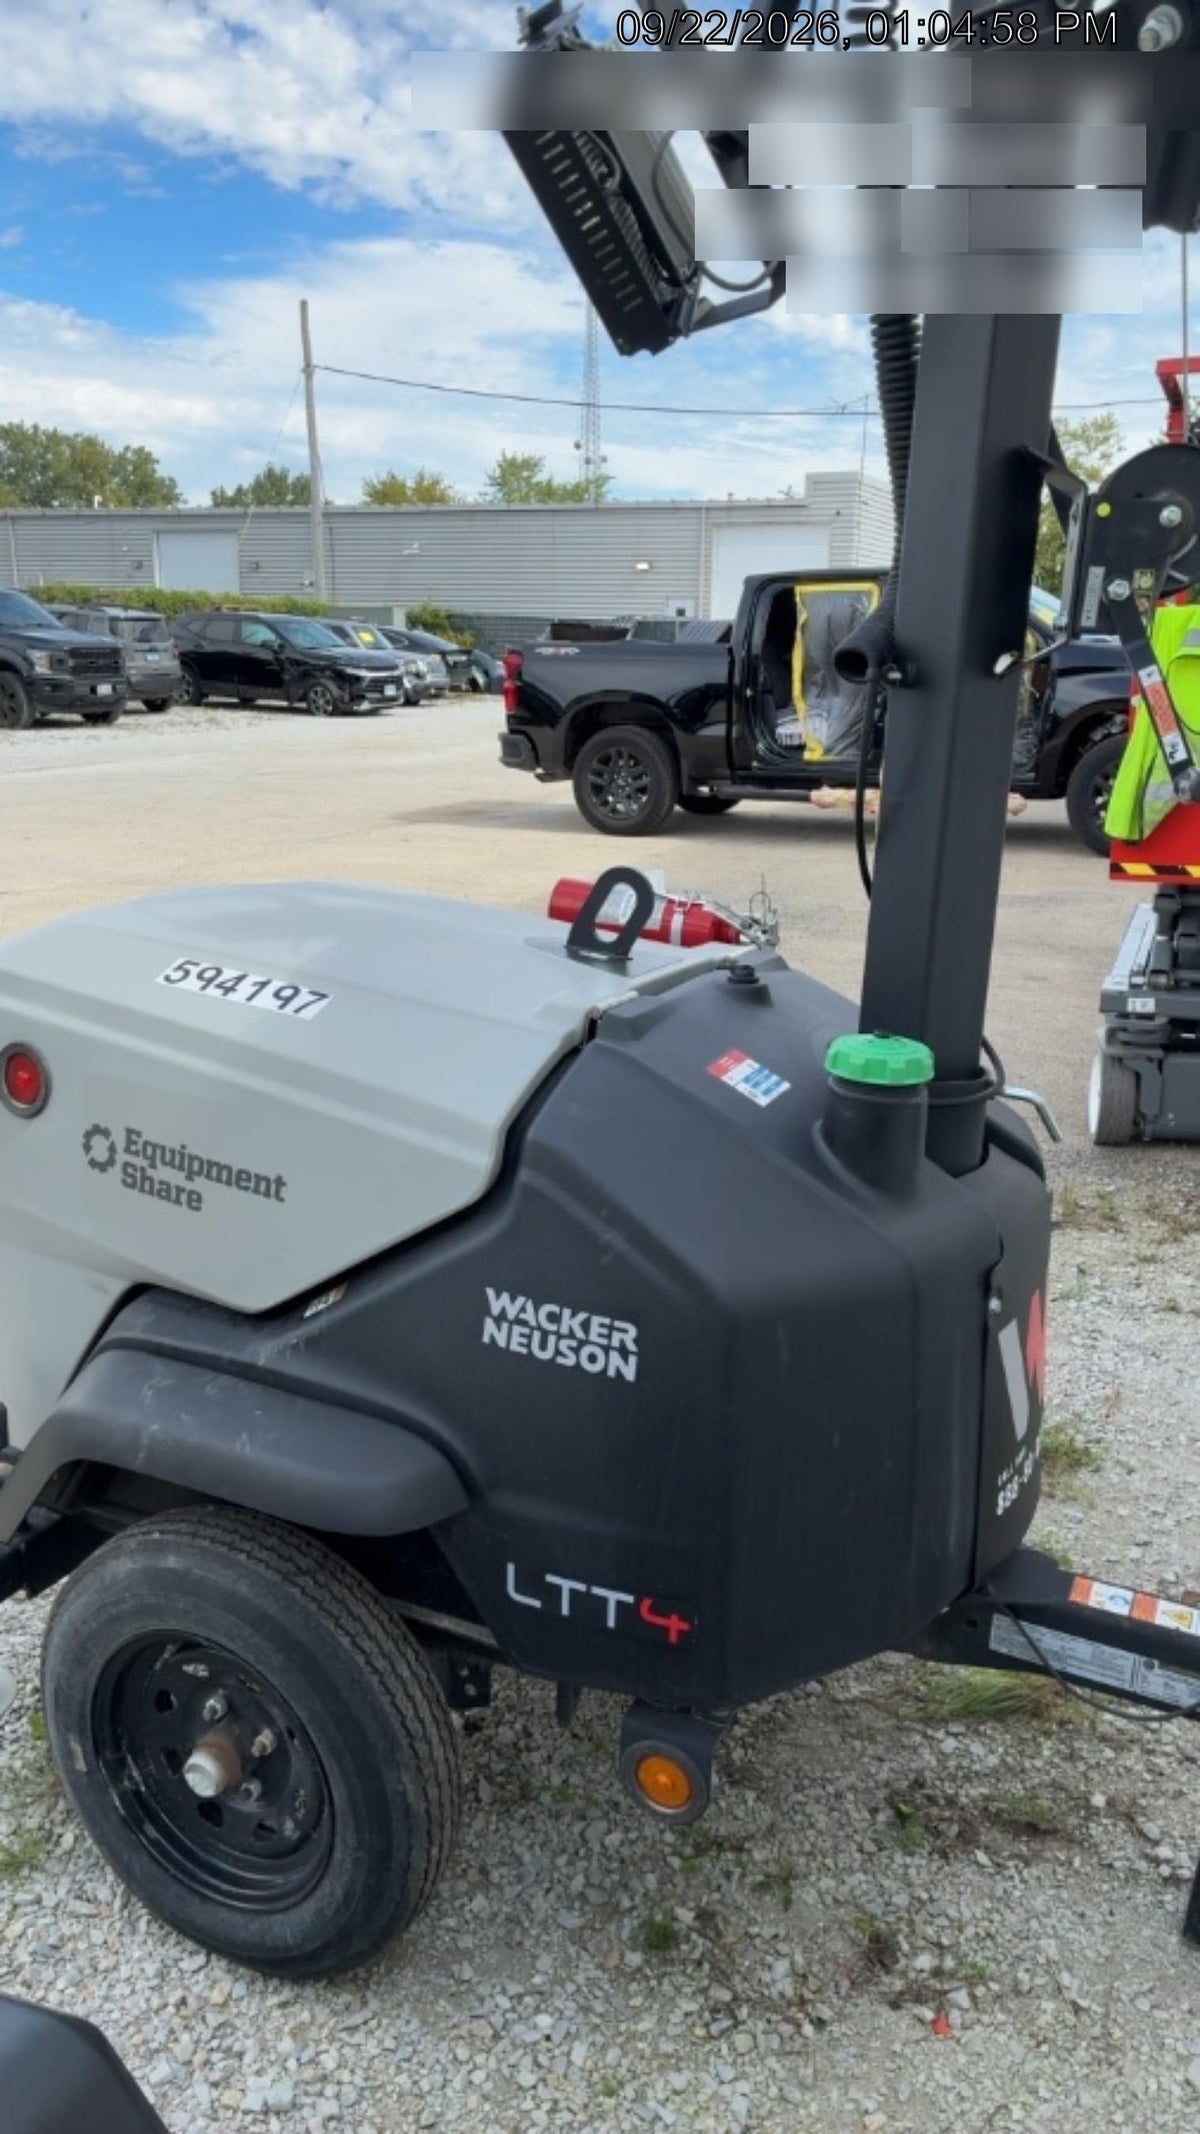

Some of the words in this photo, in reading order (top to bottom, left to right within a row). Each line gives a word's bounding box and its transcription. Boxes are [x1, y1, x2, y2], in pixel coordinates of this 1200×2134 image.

[163, 959, 330, 1014] 594197
[121, 1161, 203, 1212] Share
[123, 1126, 287, 1203] Equipment
[481, 1316, 638, 1382] NEUSON
[485, 1287, 639, 1352] WACKER
[506, 1562, 691, 1644] LTT4
